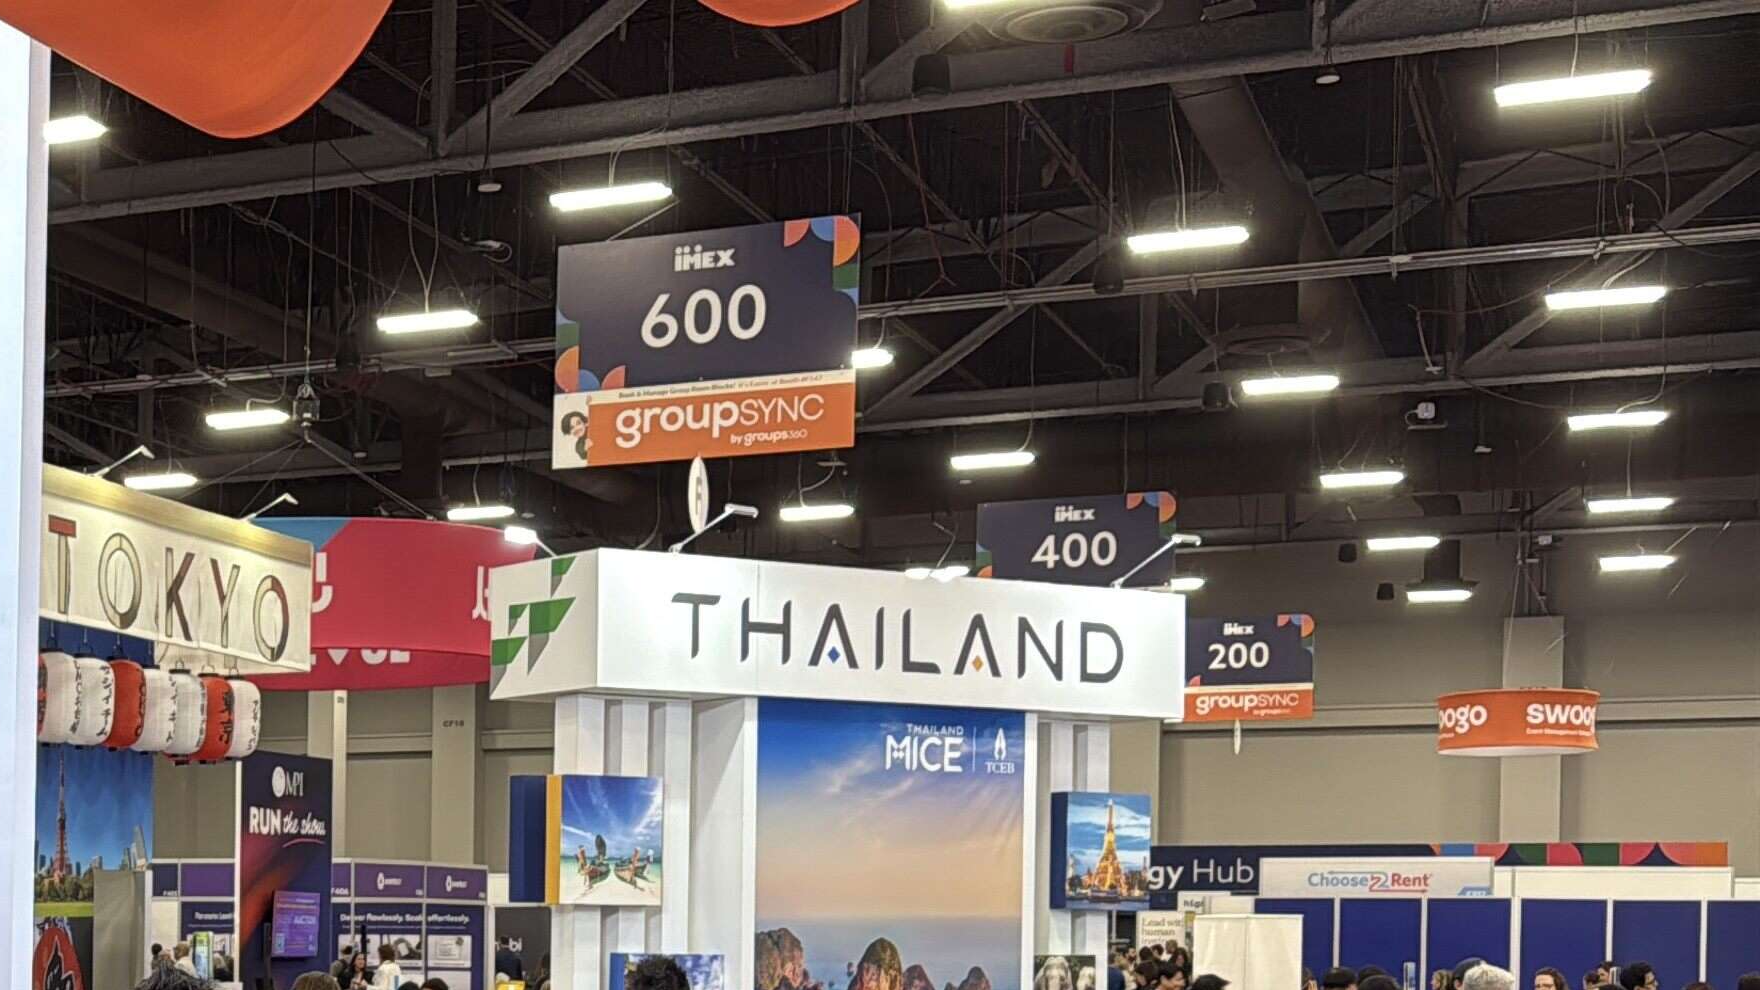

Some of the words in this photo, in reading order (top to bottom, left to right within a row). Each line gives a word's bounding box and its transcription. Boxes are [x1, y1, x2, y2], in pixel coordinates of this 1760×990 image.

[640, 284, 767, 349] 600
[730, 434, 743, 445] by
[1031, 530, 1118, 569] 400
[48, 513, 290, 663] TOKYO
[671, 592, 1125, 684] THAILAND
[1207, 641, 1271, 670] 200
[906, 722, 965, 737] THAILAND
[885, 734, 964, 773] MICE
[984, 761, 1015, 774] TCEB
[285, 771, 304, 798] MPI
[249, 805, 282, 836] RUN
[282, 810, 299, 835] the
[1147, 864, 1185, 890] gy
[1192, 858, 1255, 885] Hub
